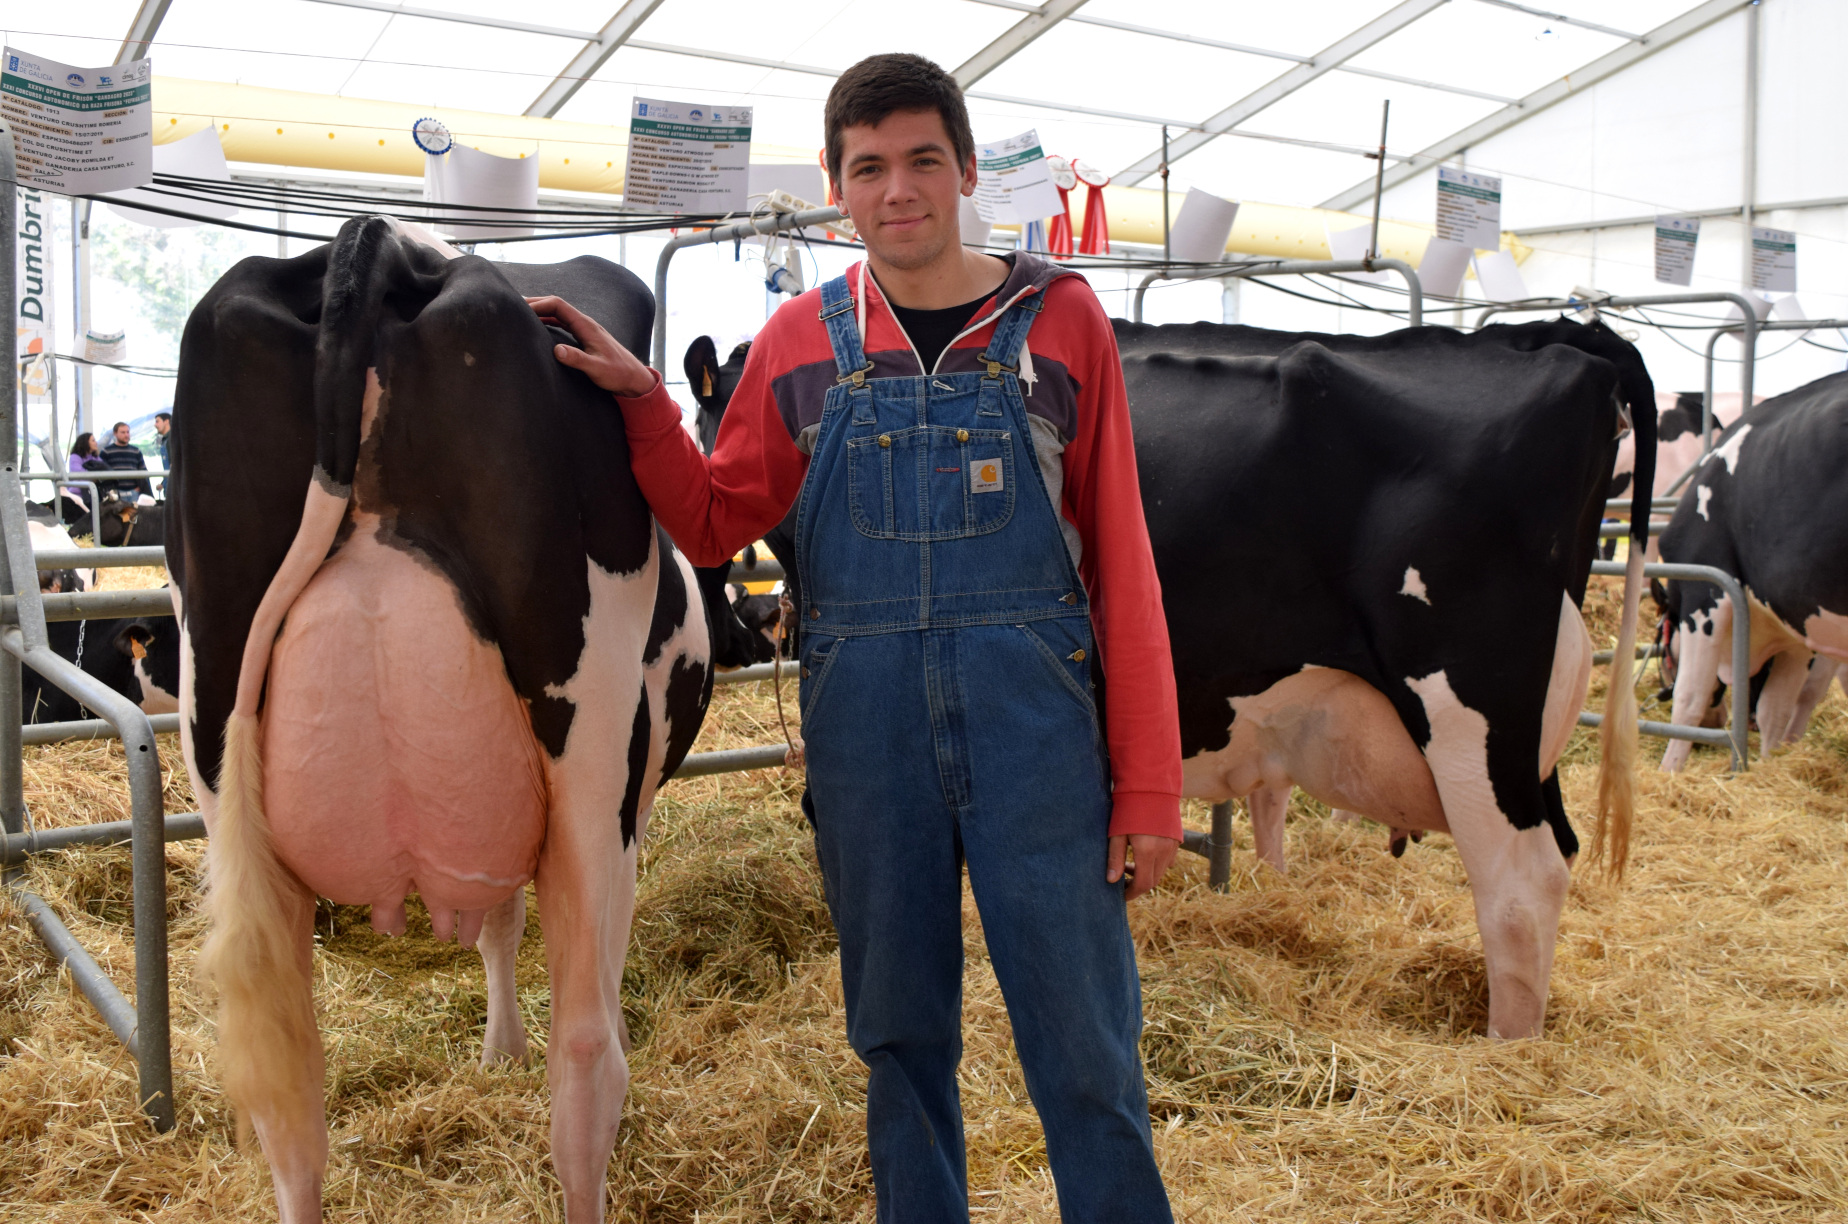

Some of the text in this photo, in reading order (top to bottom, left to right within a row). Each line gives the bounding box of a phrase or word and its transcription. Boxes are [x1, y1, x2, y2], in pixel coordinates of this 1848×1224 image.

[20, 60, 41, 71] XUNTA
[19, 66, 54, 81] DE GALICIA
[2, 83, 15, 92] XXXI
[15, 87, 43, 100] CONCURSO
[103, 99, 123, 107] FRISONA
[27, 83, 45, 93] XXXVI
[45, 86, 61, 97] OPEN
[72, 93, 94, 102] FRISÓN
[2, 104, 28, 116] NOMBRE:
[30, 112, 60, 124] VENTURO
[61, 120, 97, 129] CRUSHTIME
[46, 107, 60, 115] 1913
[1, 113, 20, 123] FECHA
[30, 122, 72, 136] NACIMIENTO:
[9, 125, 40, 138] EGISTRO:
[645, 128, 670, 136] CONCURSO
[22, 138, 35, 146] COL
[46, 144, 84, 155] CRUSHTIME
[632, 144, 658, 152] NOMBRE:
[23, 147, 53, 159] VENTURO
[54, 155, 80, 164] JACOBY
[32, 158, 43, 166] DE:
[45, 162, 83, 172] GANADERIA
[100, 163, 126, 171] VENTURO,
[33, 177, 66, 188] ASTURIAS
[629, 182, 659, 190] PROPIEDAD
[627, 197, 657, 206] PROVINCIA:
[18, 187, 44, 323] Dumbrí
